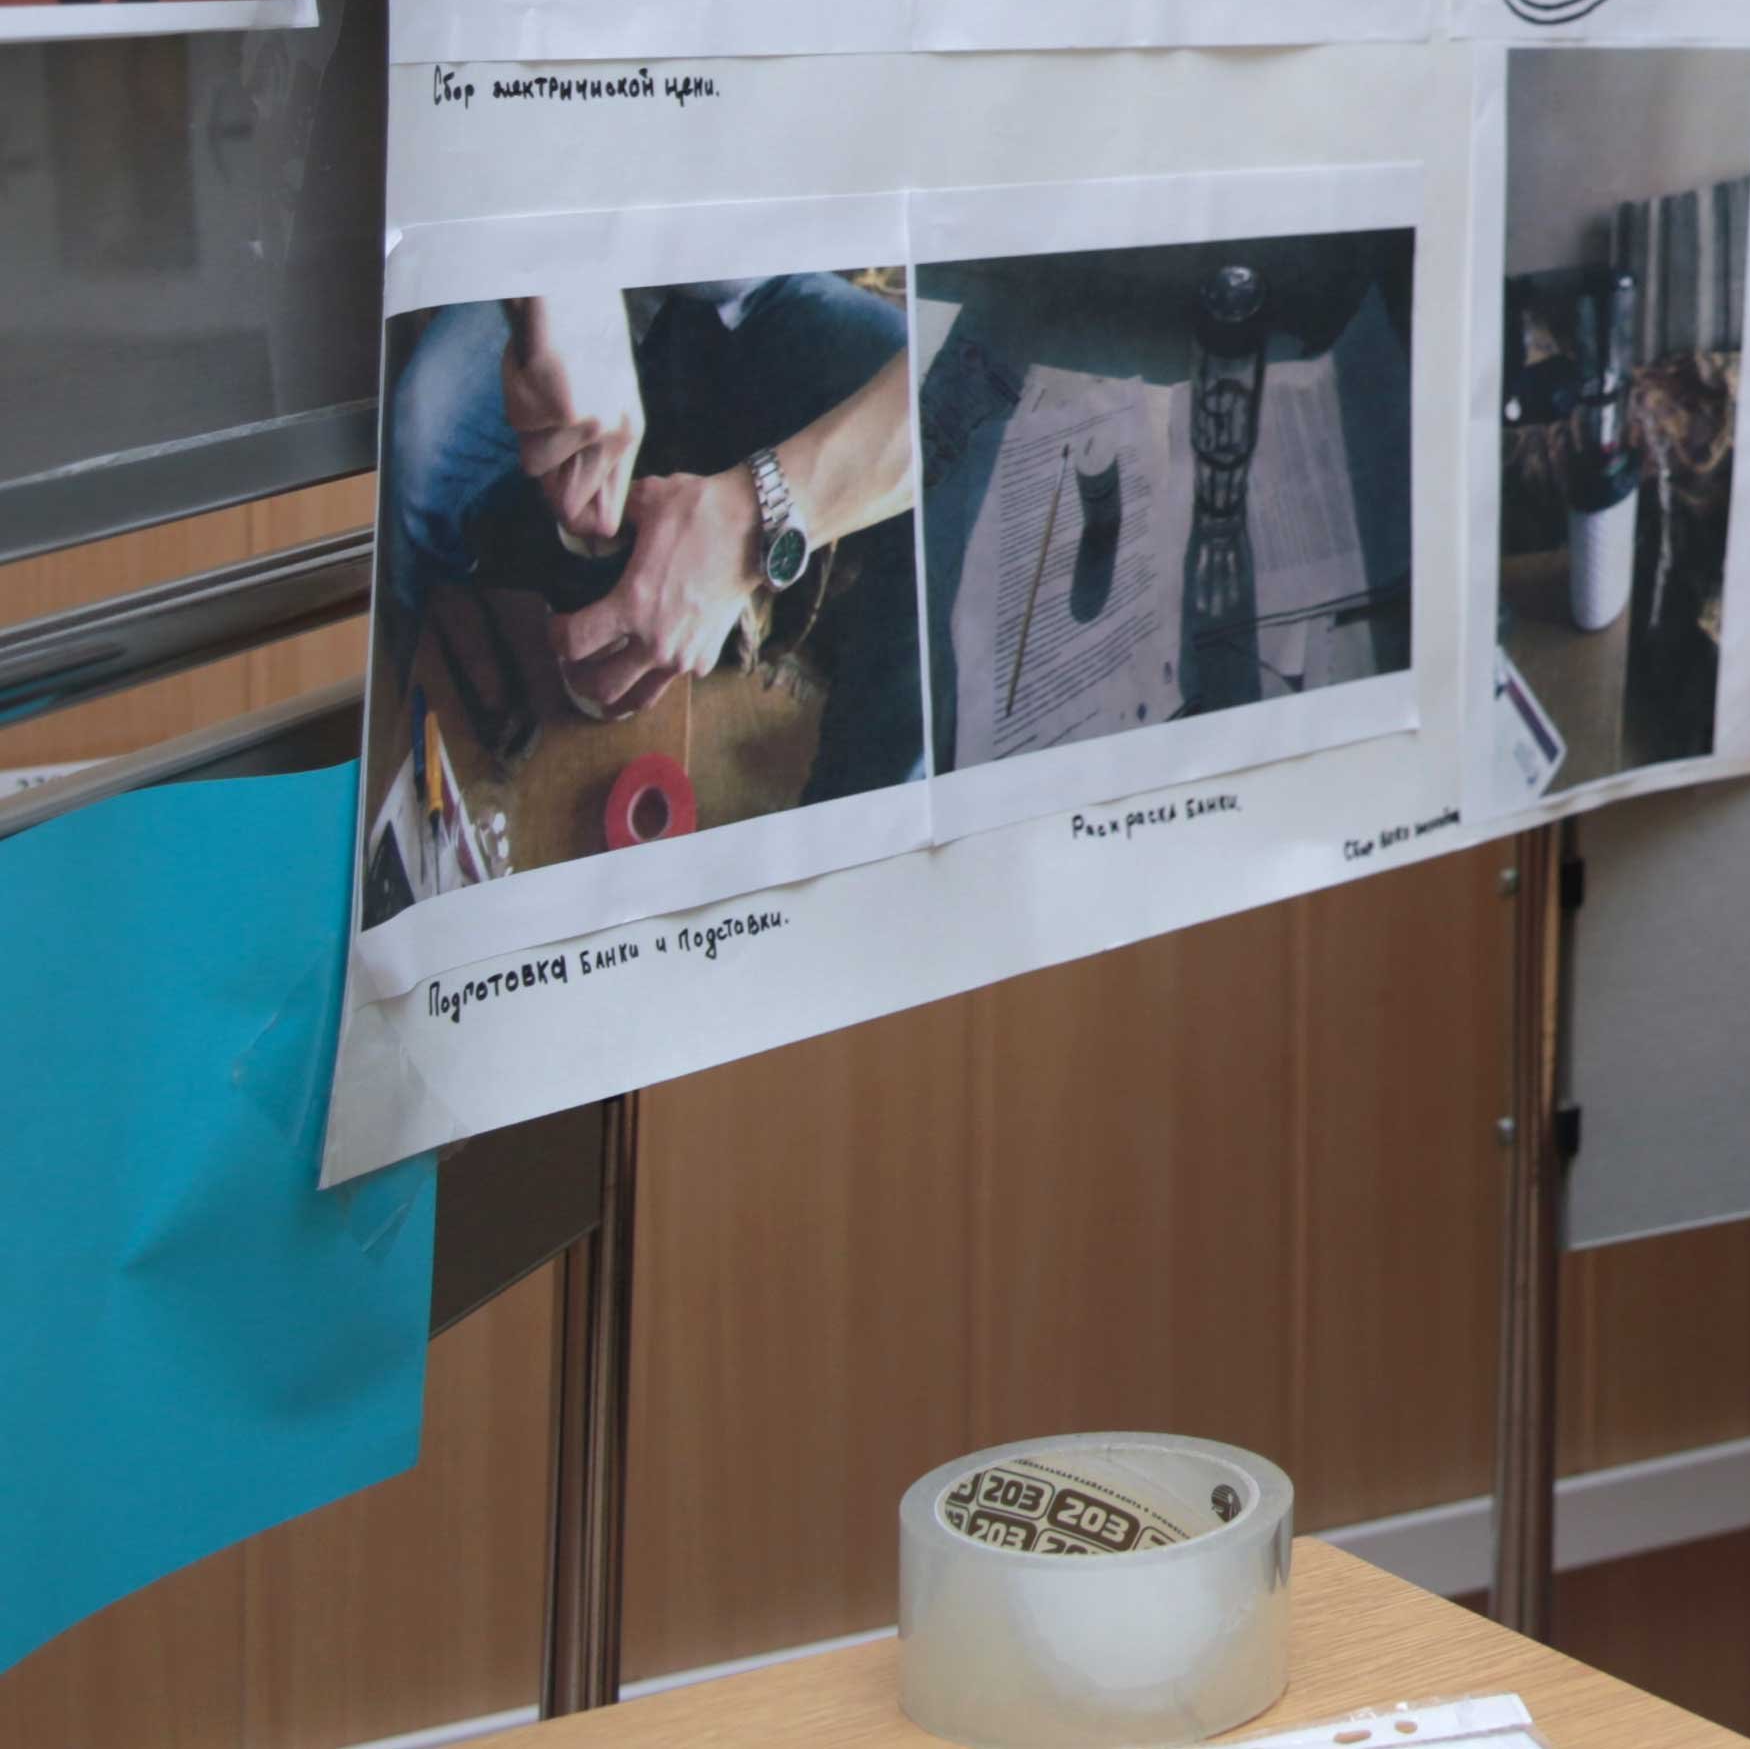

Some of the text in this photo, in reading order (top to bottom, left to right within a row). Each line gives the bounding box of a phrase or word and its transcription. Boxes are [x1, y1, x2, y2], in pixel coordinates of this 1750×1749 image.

[433, 64, 475, 110] Сбор
[428, 954, 568, 1024] Подготовка
[983, 1475, 1045, 1512] 203
[1056, 1496, 1130, 1544] 203
